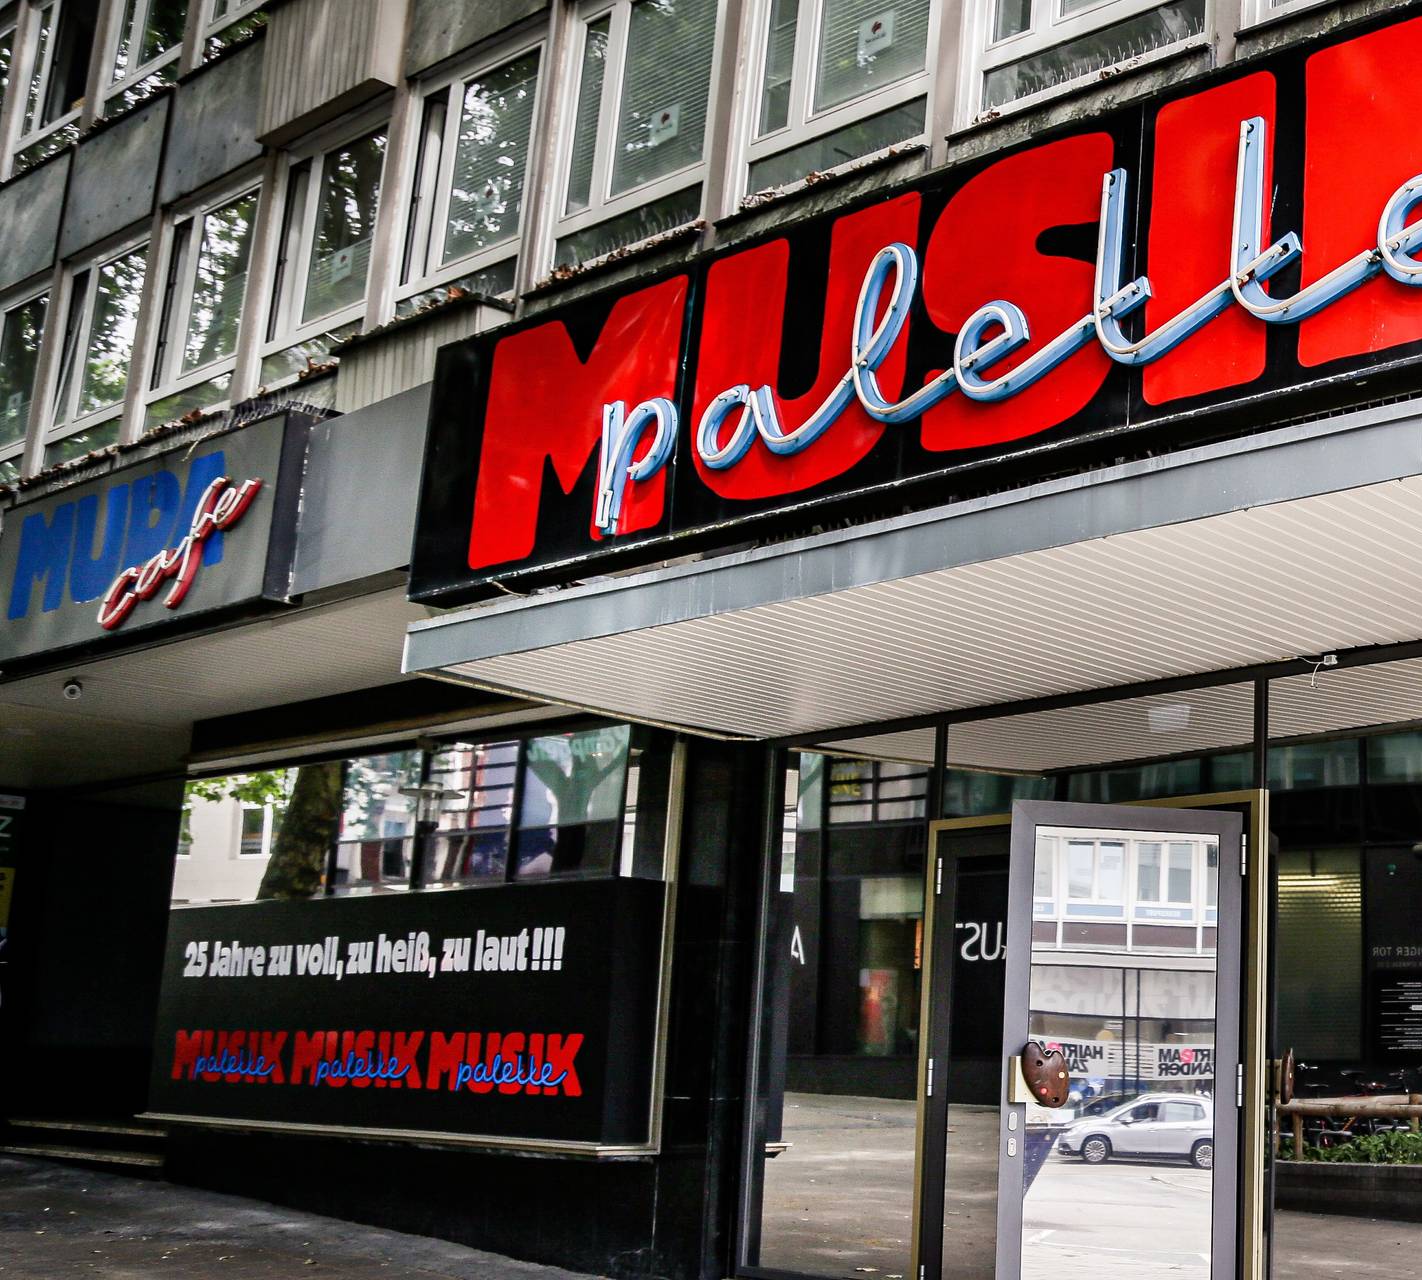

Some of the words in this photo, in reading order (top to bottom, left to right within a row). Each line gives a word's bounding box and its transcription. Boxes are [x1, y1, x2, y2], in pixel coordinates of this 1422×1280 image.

[183, 941, 209, 977] 25
[209, 940, 265, 977] Jahre
[267, 944, 293, 976] zu
[296, 935, 344, 981] voll,
[345, 941, 374, 975] zu
[375, 931, 437, 978] heiß,
[440, 937, 472, 972] zu
[170, 1029, 289, 1085] MUSIK
[290, 1030, 425, 1089] MUSIK
[426, 1031, 585, 1097] MUSIK
[193, 1048, 275, 1080] palette
[314, 1050, 410, 1087] palette
[455, 1054, 568, 1092] palette
